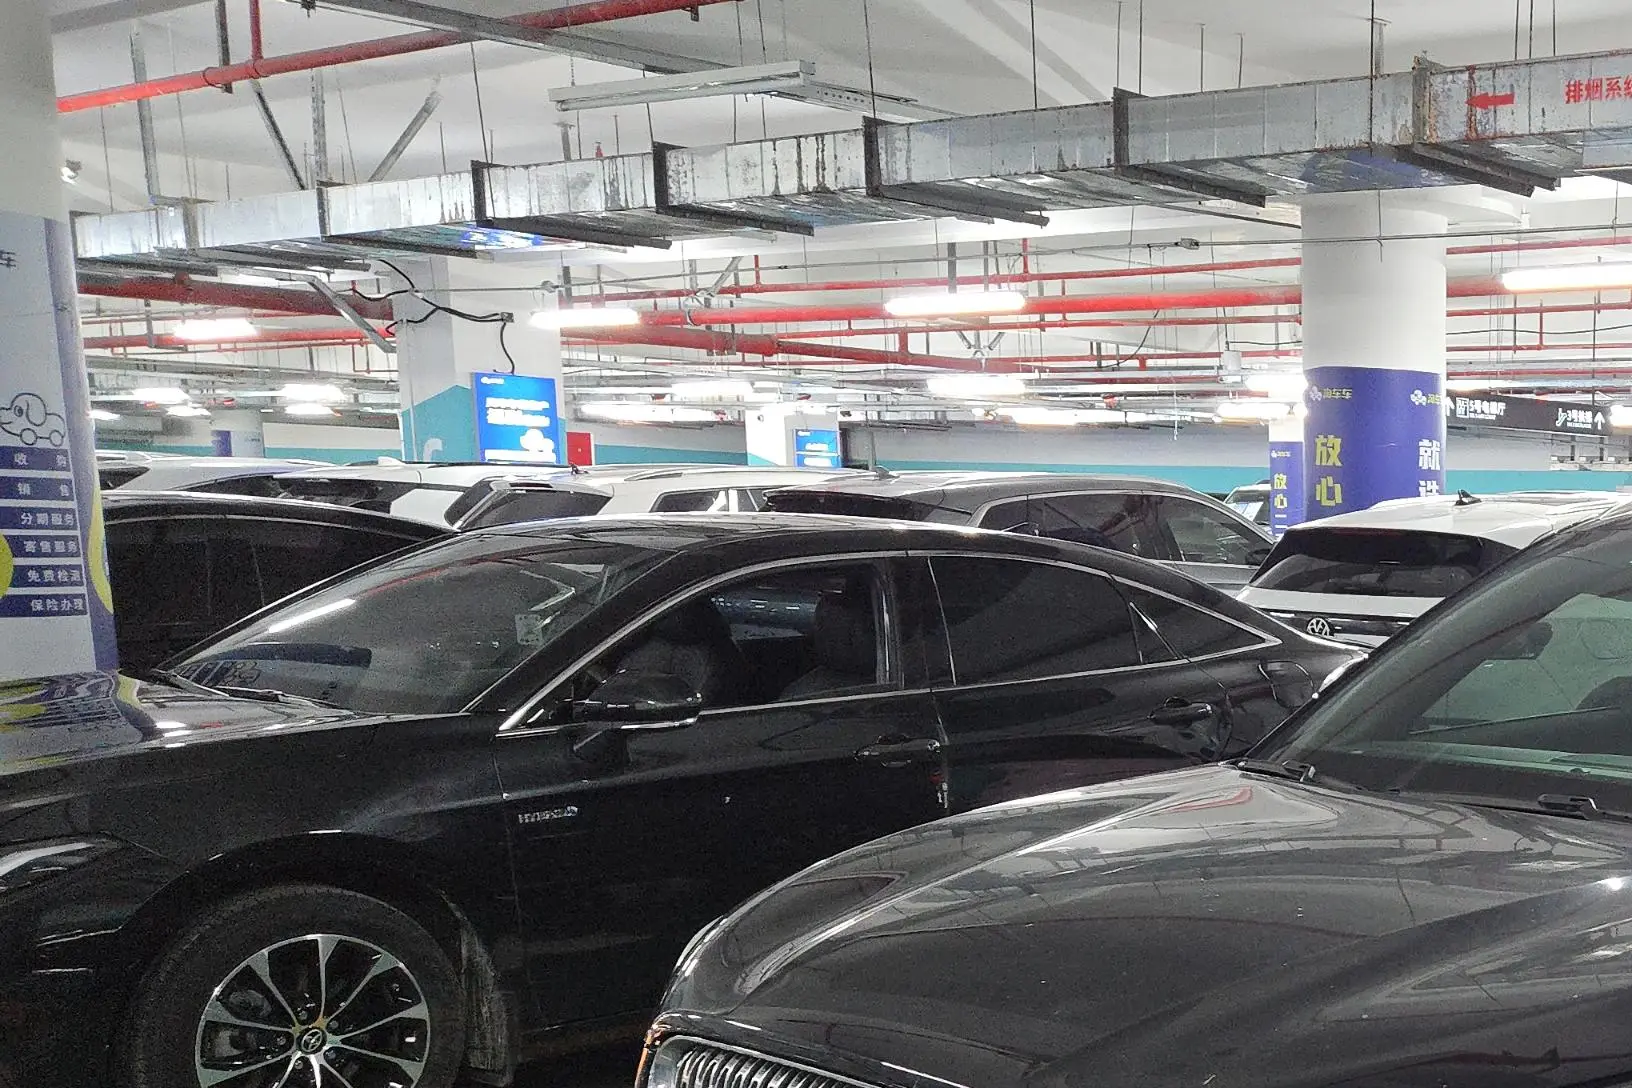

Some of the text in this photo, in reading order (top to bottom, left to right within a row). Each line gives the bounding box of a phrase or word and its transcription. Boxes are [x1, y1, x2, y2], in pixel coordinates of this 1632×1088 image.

[1315, 435, 1343, 507] 放心
[20, 512, 75, 527] 分期服务
[27, 569, 81, 583] 免费检测
[30, 598, 85, 612] 保险办理
